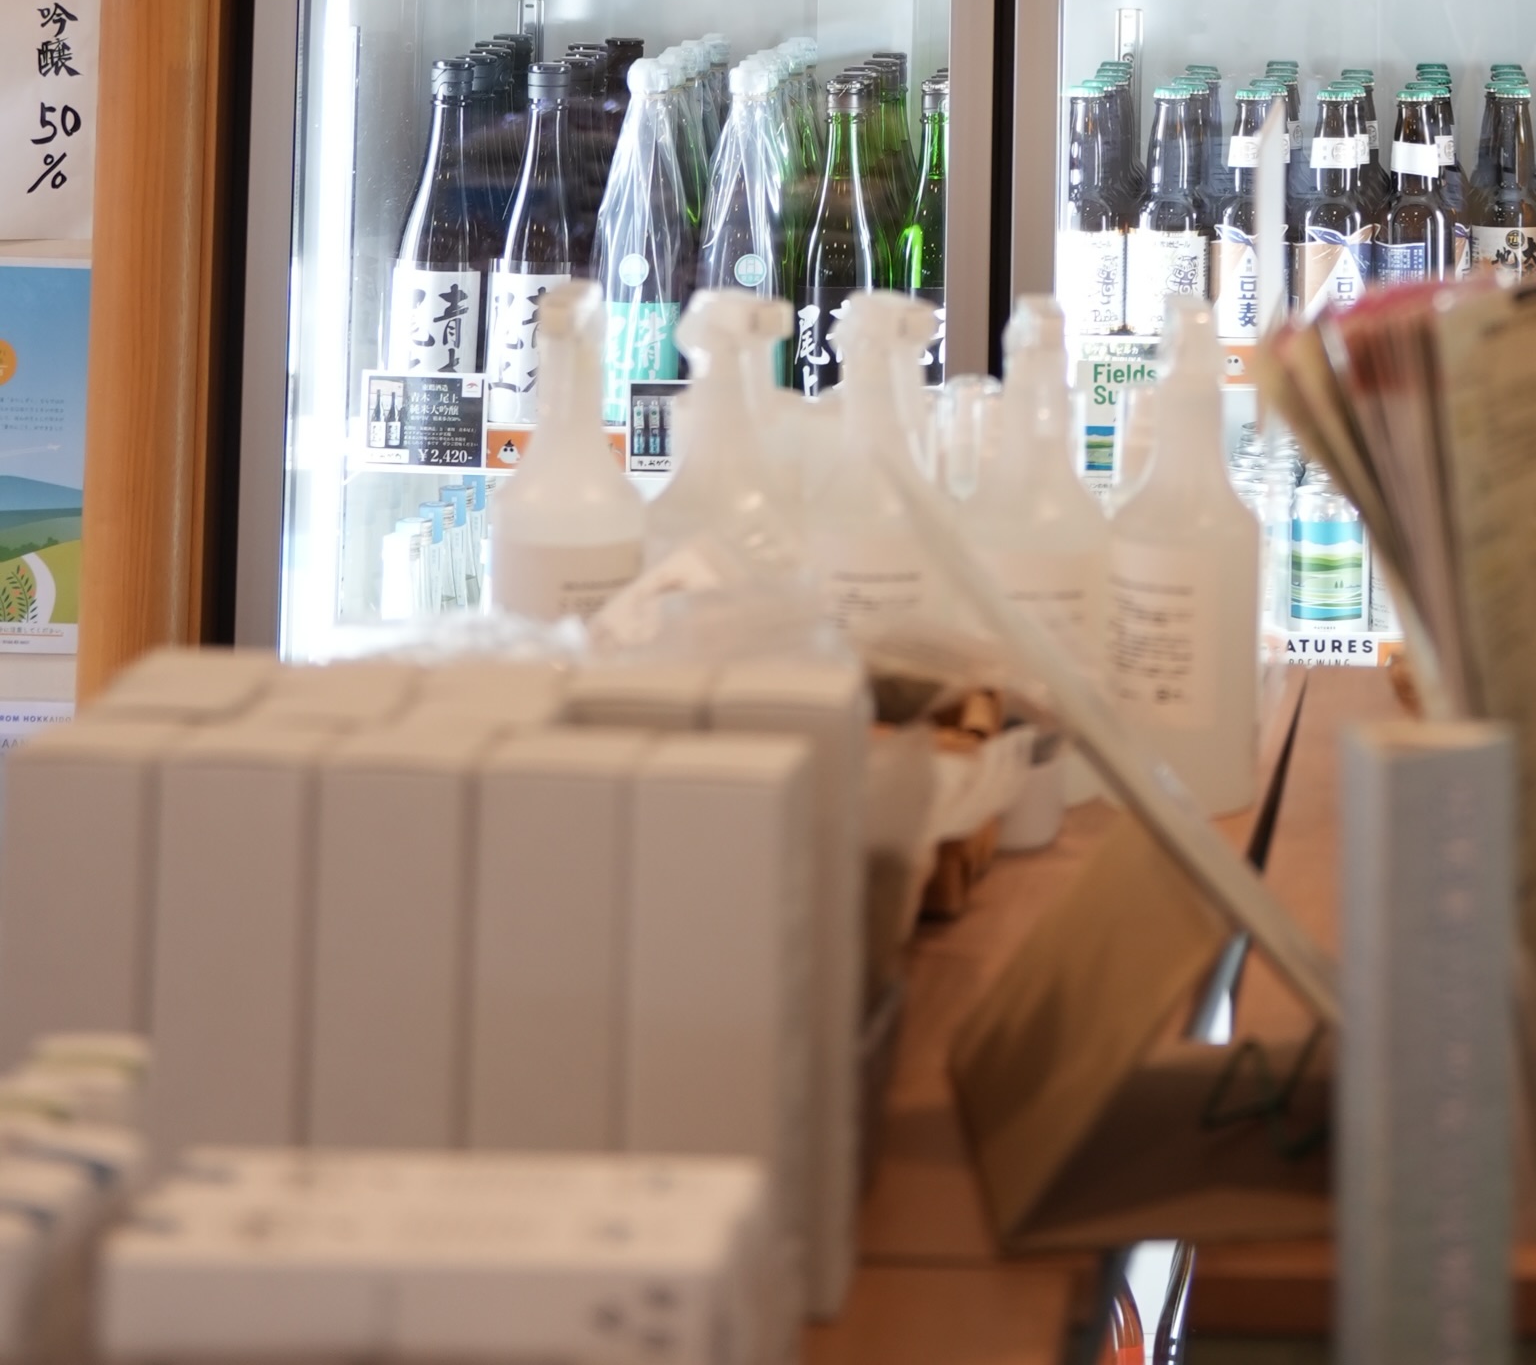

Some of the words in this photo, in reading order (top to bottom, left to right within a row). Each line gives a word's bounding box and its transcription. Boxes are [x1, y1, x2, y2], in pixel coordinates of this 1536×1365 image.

[1093, 363, 1158, 384] Fields
[1286, 639, 1374, 654] ATURES
[0, 715, 20, 723] ROM
